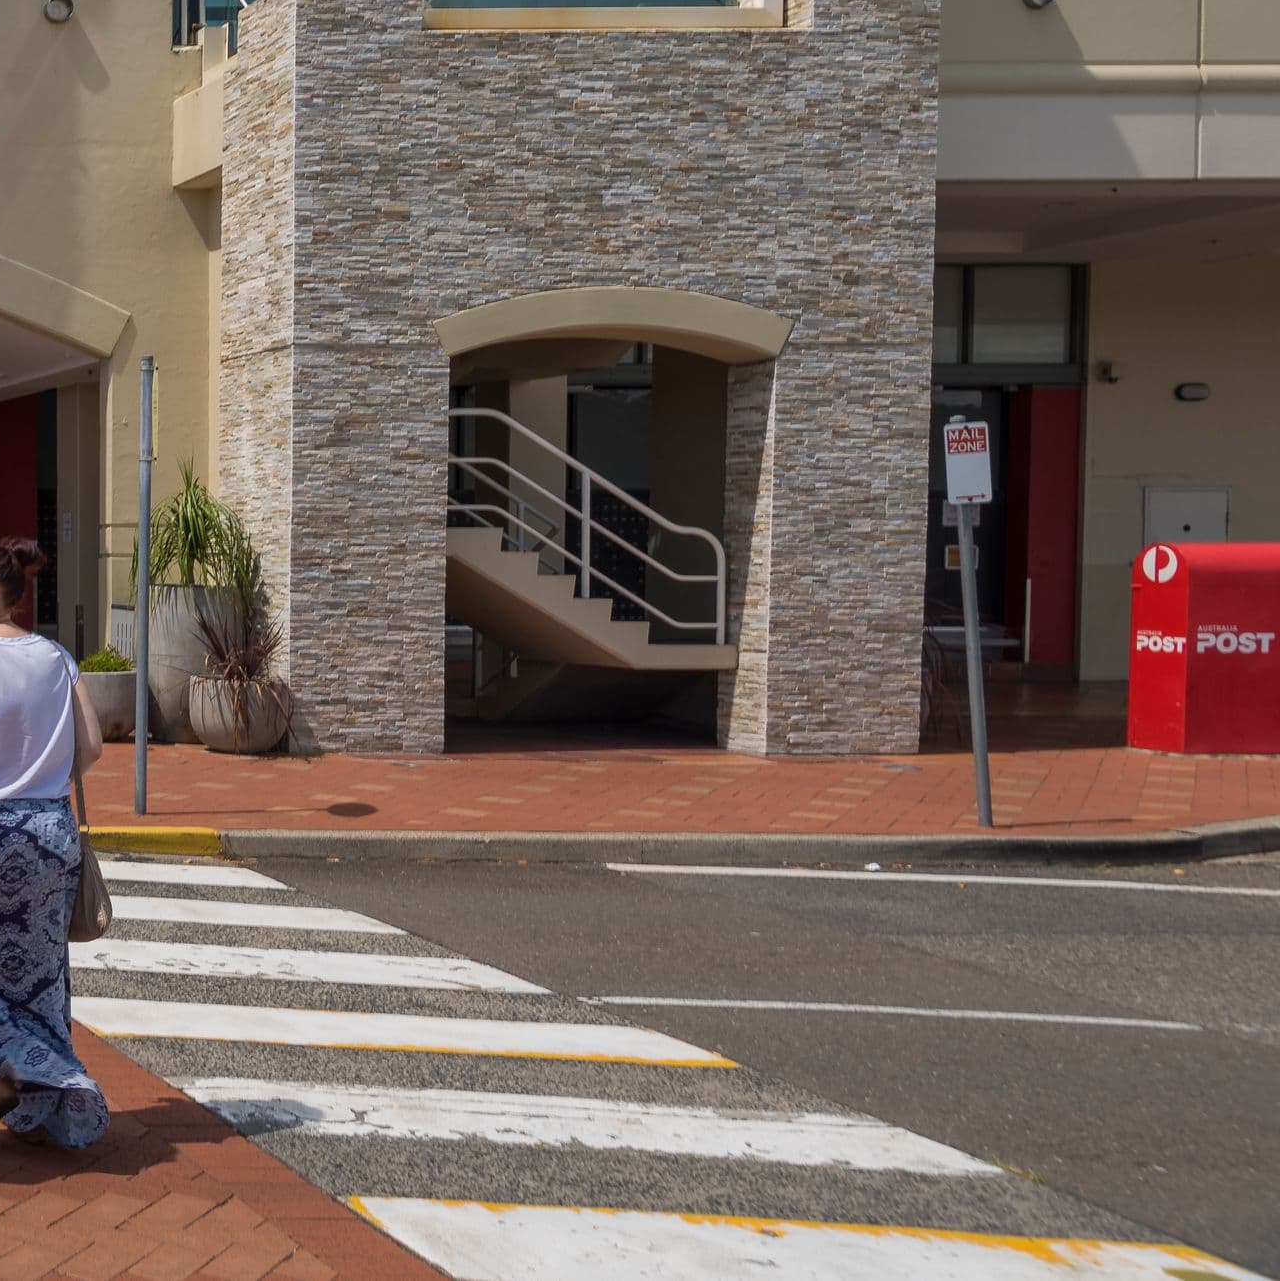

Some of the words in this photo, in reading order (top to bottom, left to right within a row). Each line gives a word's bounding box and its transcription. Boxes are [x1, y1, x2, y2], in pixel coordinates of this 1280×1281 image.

[948, 429, 984, 441] MAIL
[949, 441, 985, 453] ZONE
[1197, 624, 1238, 632] AUSTRALIA
[1136, 635, 1187, 654] POST
[1196, 632, 1276, 654] POST
